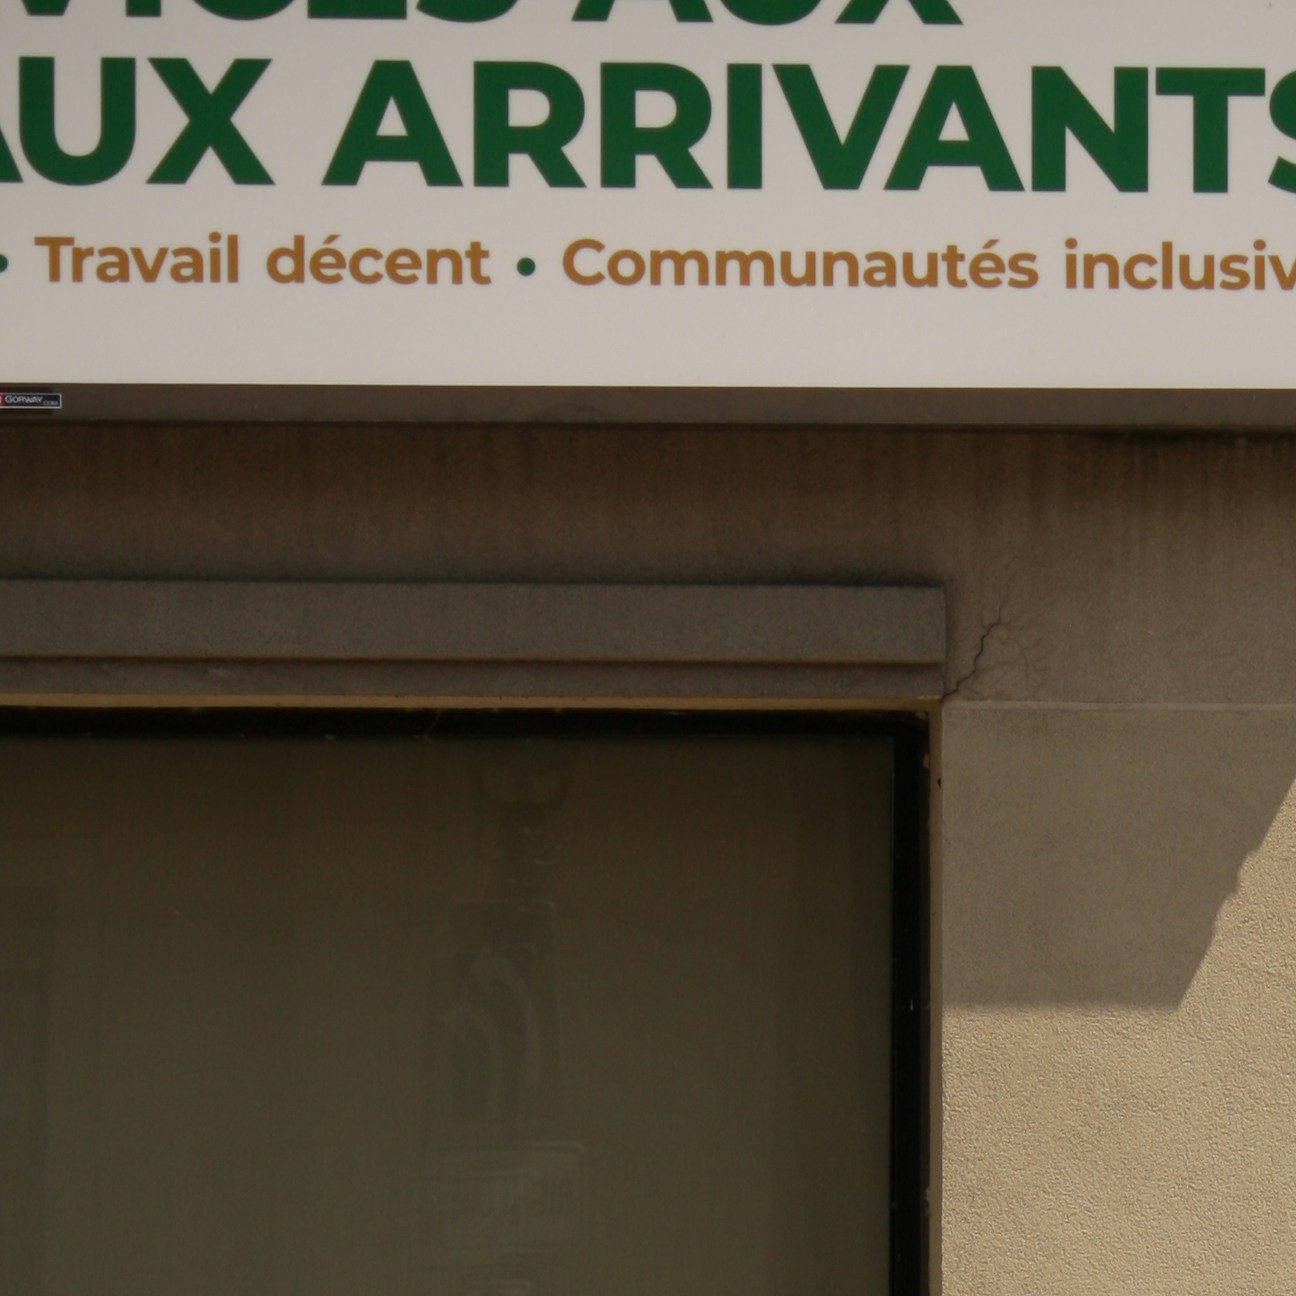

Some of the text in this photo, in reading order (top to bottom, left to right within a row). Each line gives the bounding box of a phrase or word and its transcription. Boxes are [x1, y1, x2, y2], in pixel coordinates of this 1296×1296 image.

[0, 56, 275, 186] UX
[34, 230, 239, 284] Travail
[266, 234, 491, 285] décent
[562, 237, 1039, 289] Communautés
